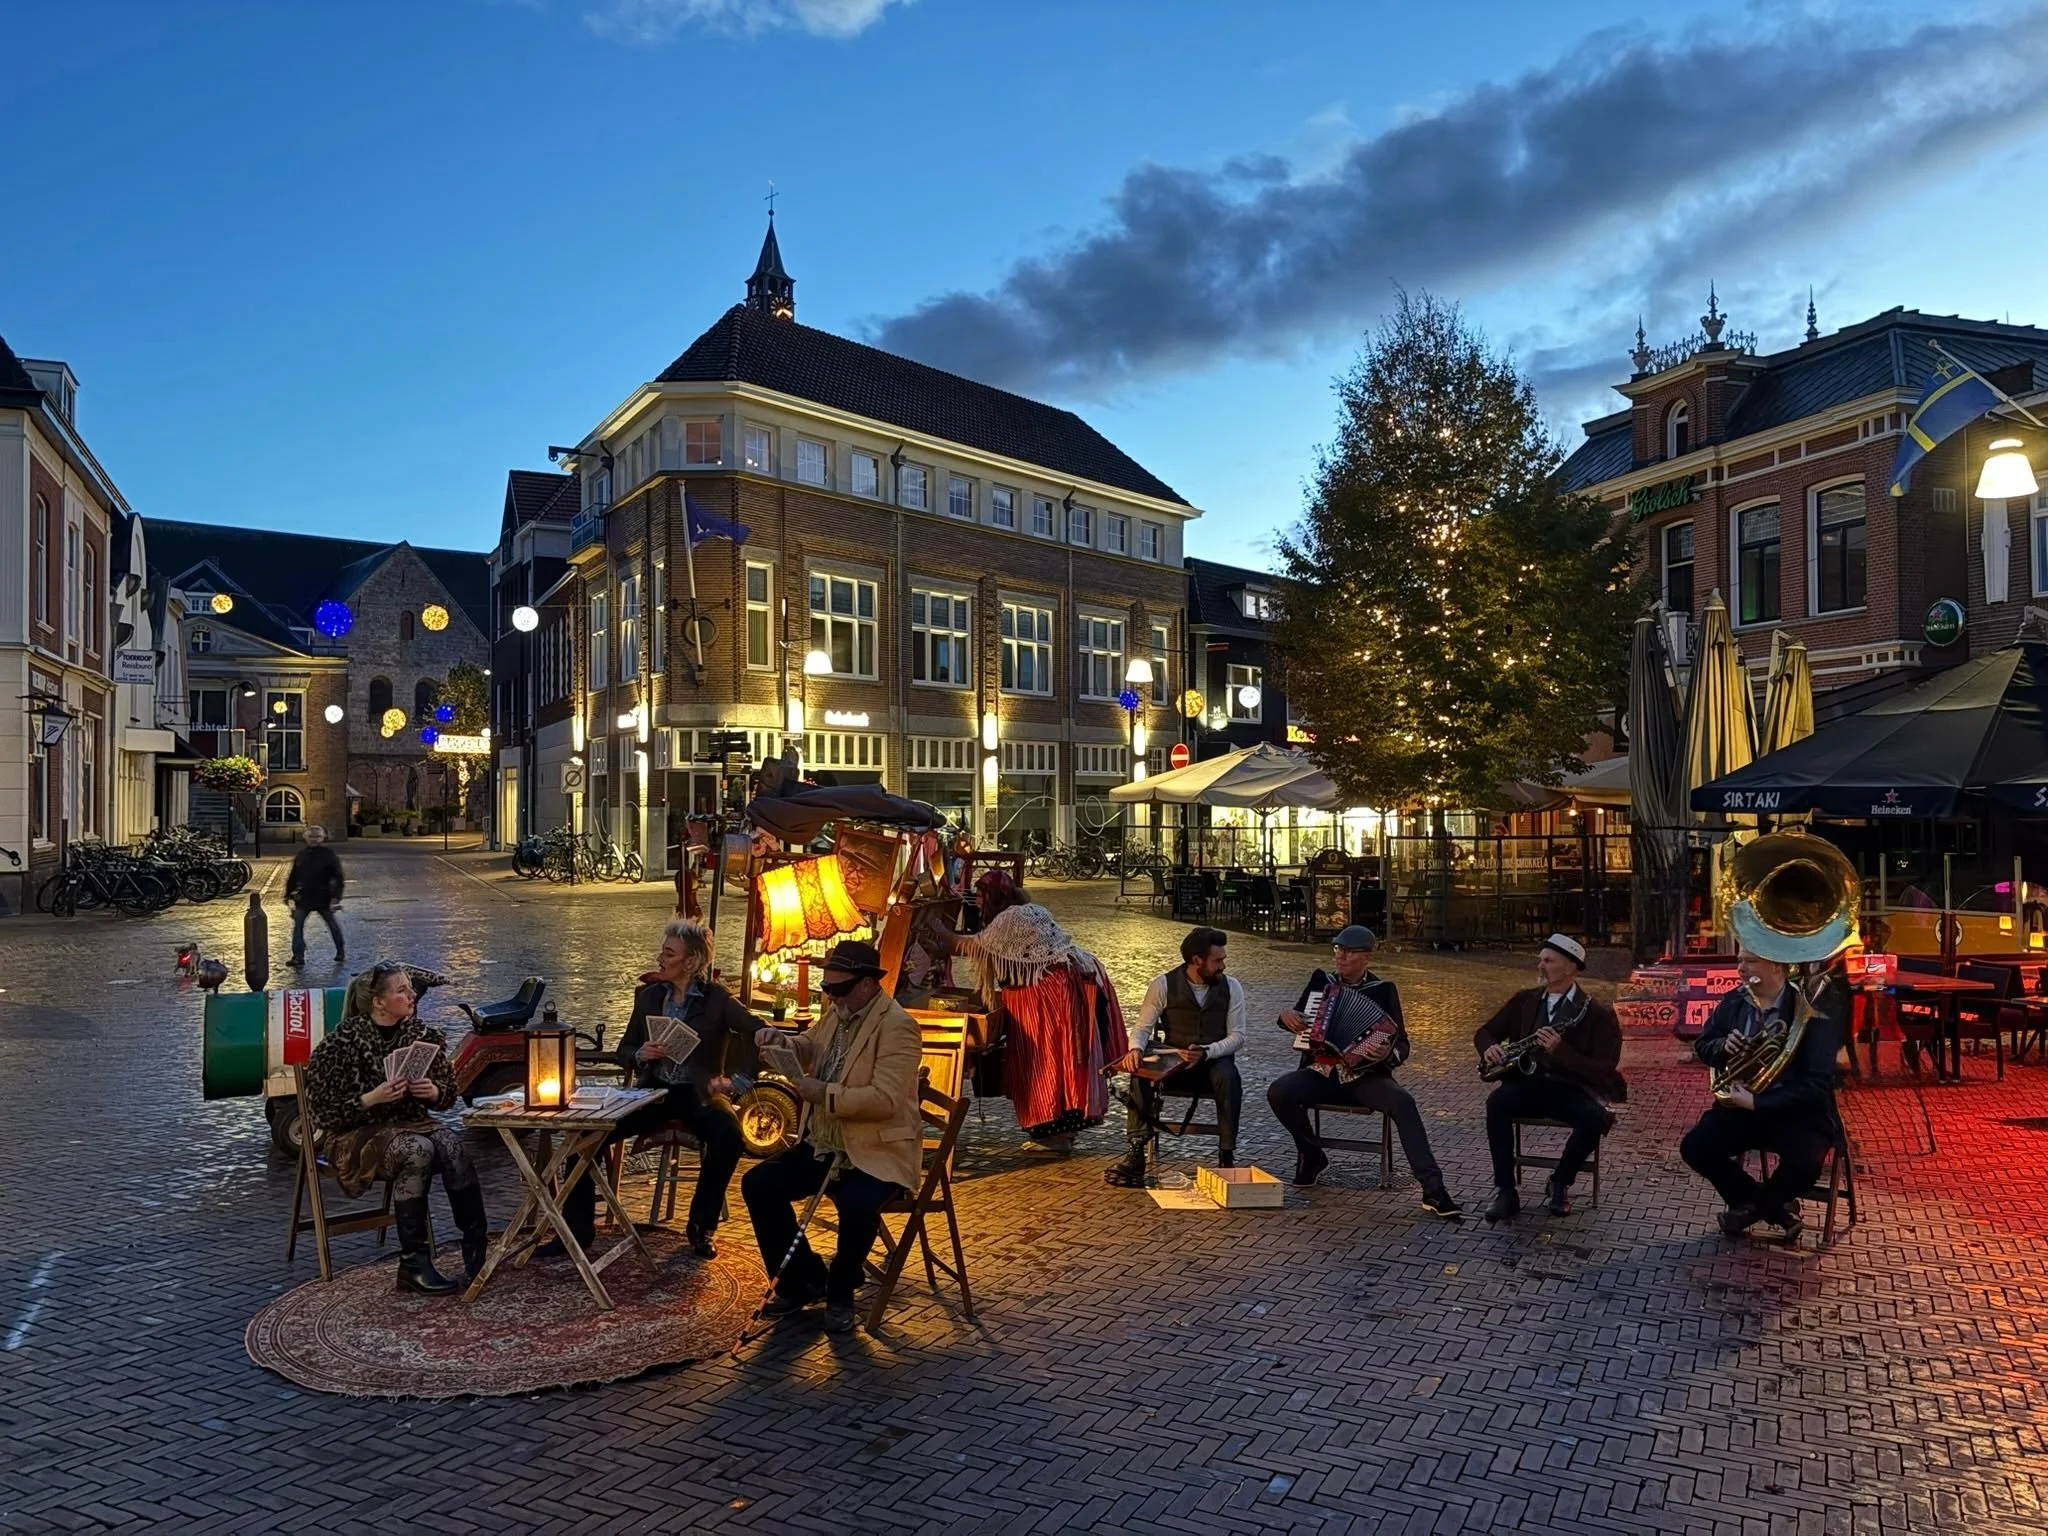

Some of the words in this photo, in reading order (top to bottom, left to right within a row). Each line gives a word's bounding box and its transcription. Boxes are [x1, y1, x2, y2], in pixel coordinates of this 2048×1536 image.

[1631, 474, 1690, 523] Grolsch
[1722, 791, 1780, 808] SIRTAKI
[1871, 804, 1912, 815] Heineken
[1319, 879, 1345, 887] LUNCH
[289, 993, 305, 1033] Castrol
